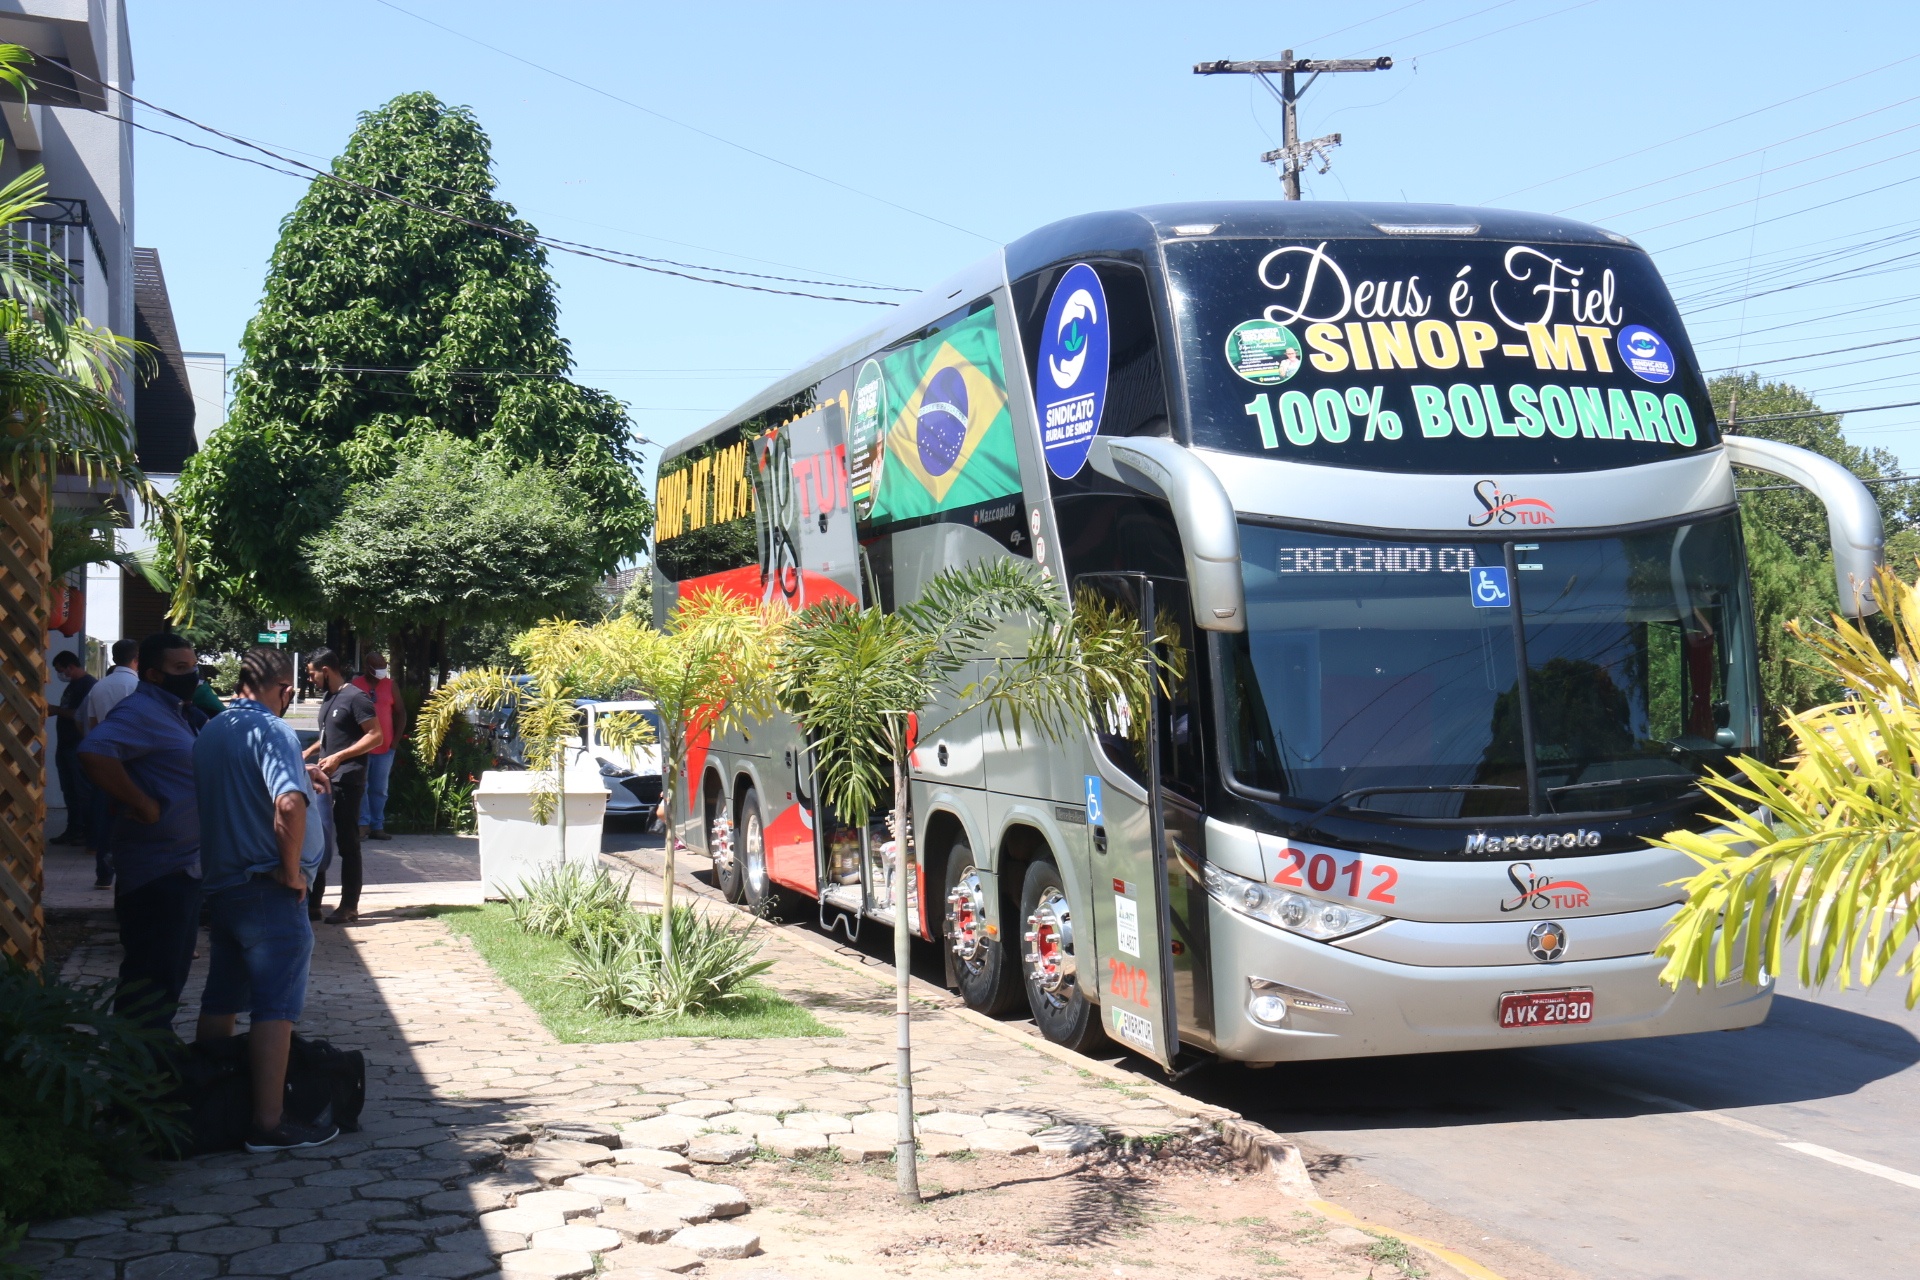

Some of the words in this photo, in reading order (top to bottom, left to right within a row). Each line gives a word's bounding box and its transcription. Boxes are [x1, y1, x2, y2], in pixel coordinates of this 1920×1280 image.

[1257, 241, 1431, 325] Deus
[1448, 265, 1473, 318] é
[1489, 245, 1622, 331] Fiel
[1304, 319, 1613, 374] SINOP-MT
[1045, 427, 1065, 443] RURAL
[1065, 424, 1075, 438] DE
[1074, 419, 1094, 436] SINOP
[1046, 398, 1095, 428] SINDICATO
[1244, 386, 1403, 449] 100%
[1410, 383, 1697, 448] BOLSONARO
[656, 457, 710, 543] SINOP-MT
[712, 439, 748, 525] 100%
[979, 503, 1016, 524] Marcopolo
[1468, 479, 1517, 527] Sig
[1464, 829, 1602, 855] Marcopolo
[1273, 847, 1400, 905] 2012
[1500, 862, 1551, 912] Sig
[1551, 893, 1590, 909] TUR
[1109, 957, 1150, 1009] 2012
[1504, 1006, 1538, 1024] AVK
[1544, 1002, 1591, 1021] 2030
